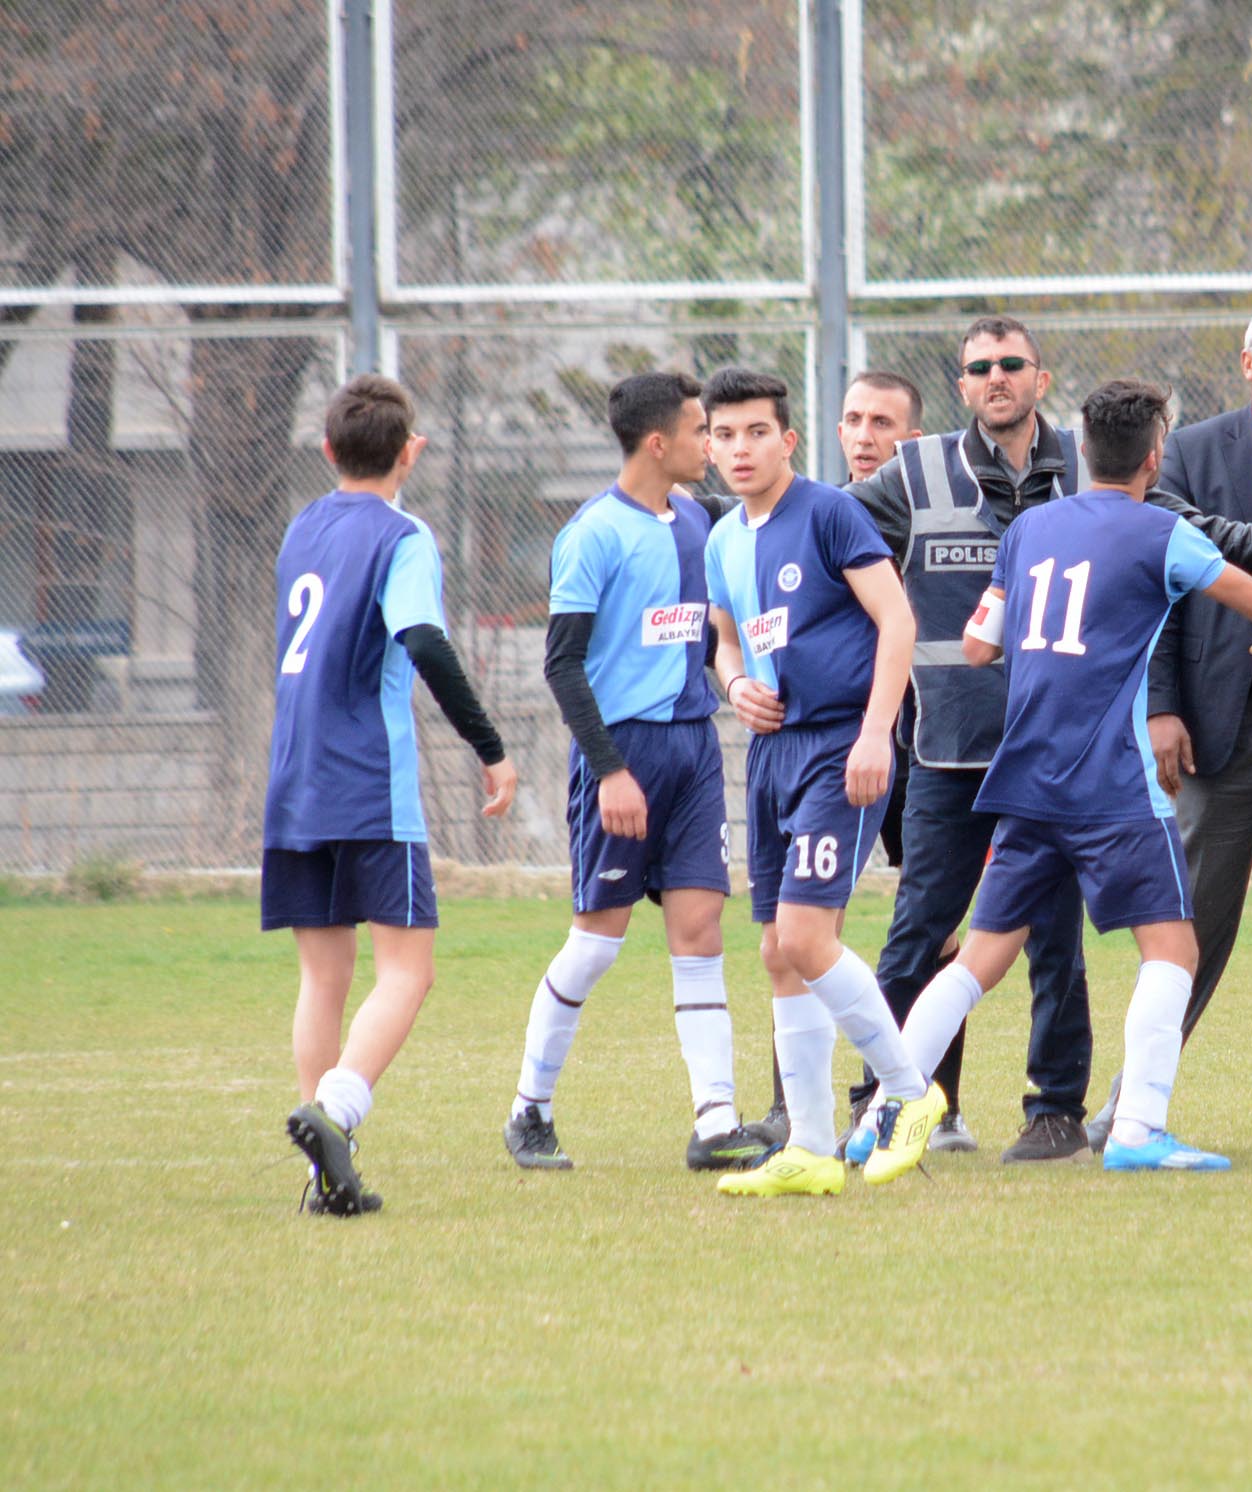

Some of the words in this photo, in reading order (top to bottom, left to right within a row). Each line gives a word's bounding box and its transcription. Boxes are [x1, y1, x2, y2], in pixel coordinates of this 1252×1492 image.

[935, 547, 998, 563] POLIS
[281, 572, 324, 675] 2
[1021, 557, 1091, 656] 11
[793, 834, 839, 880] 16
